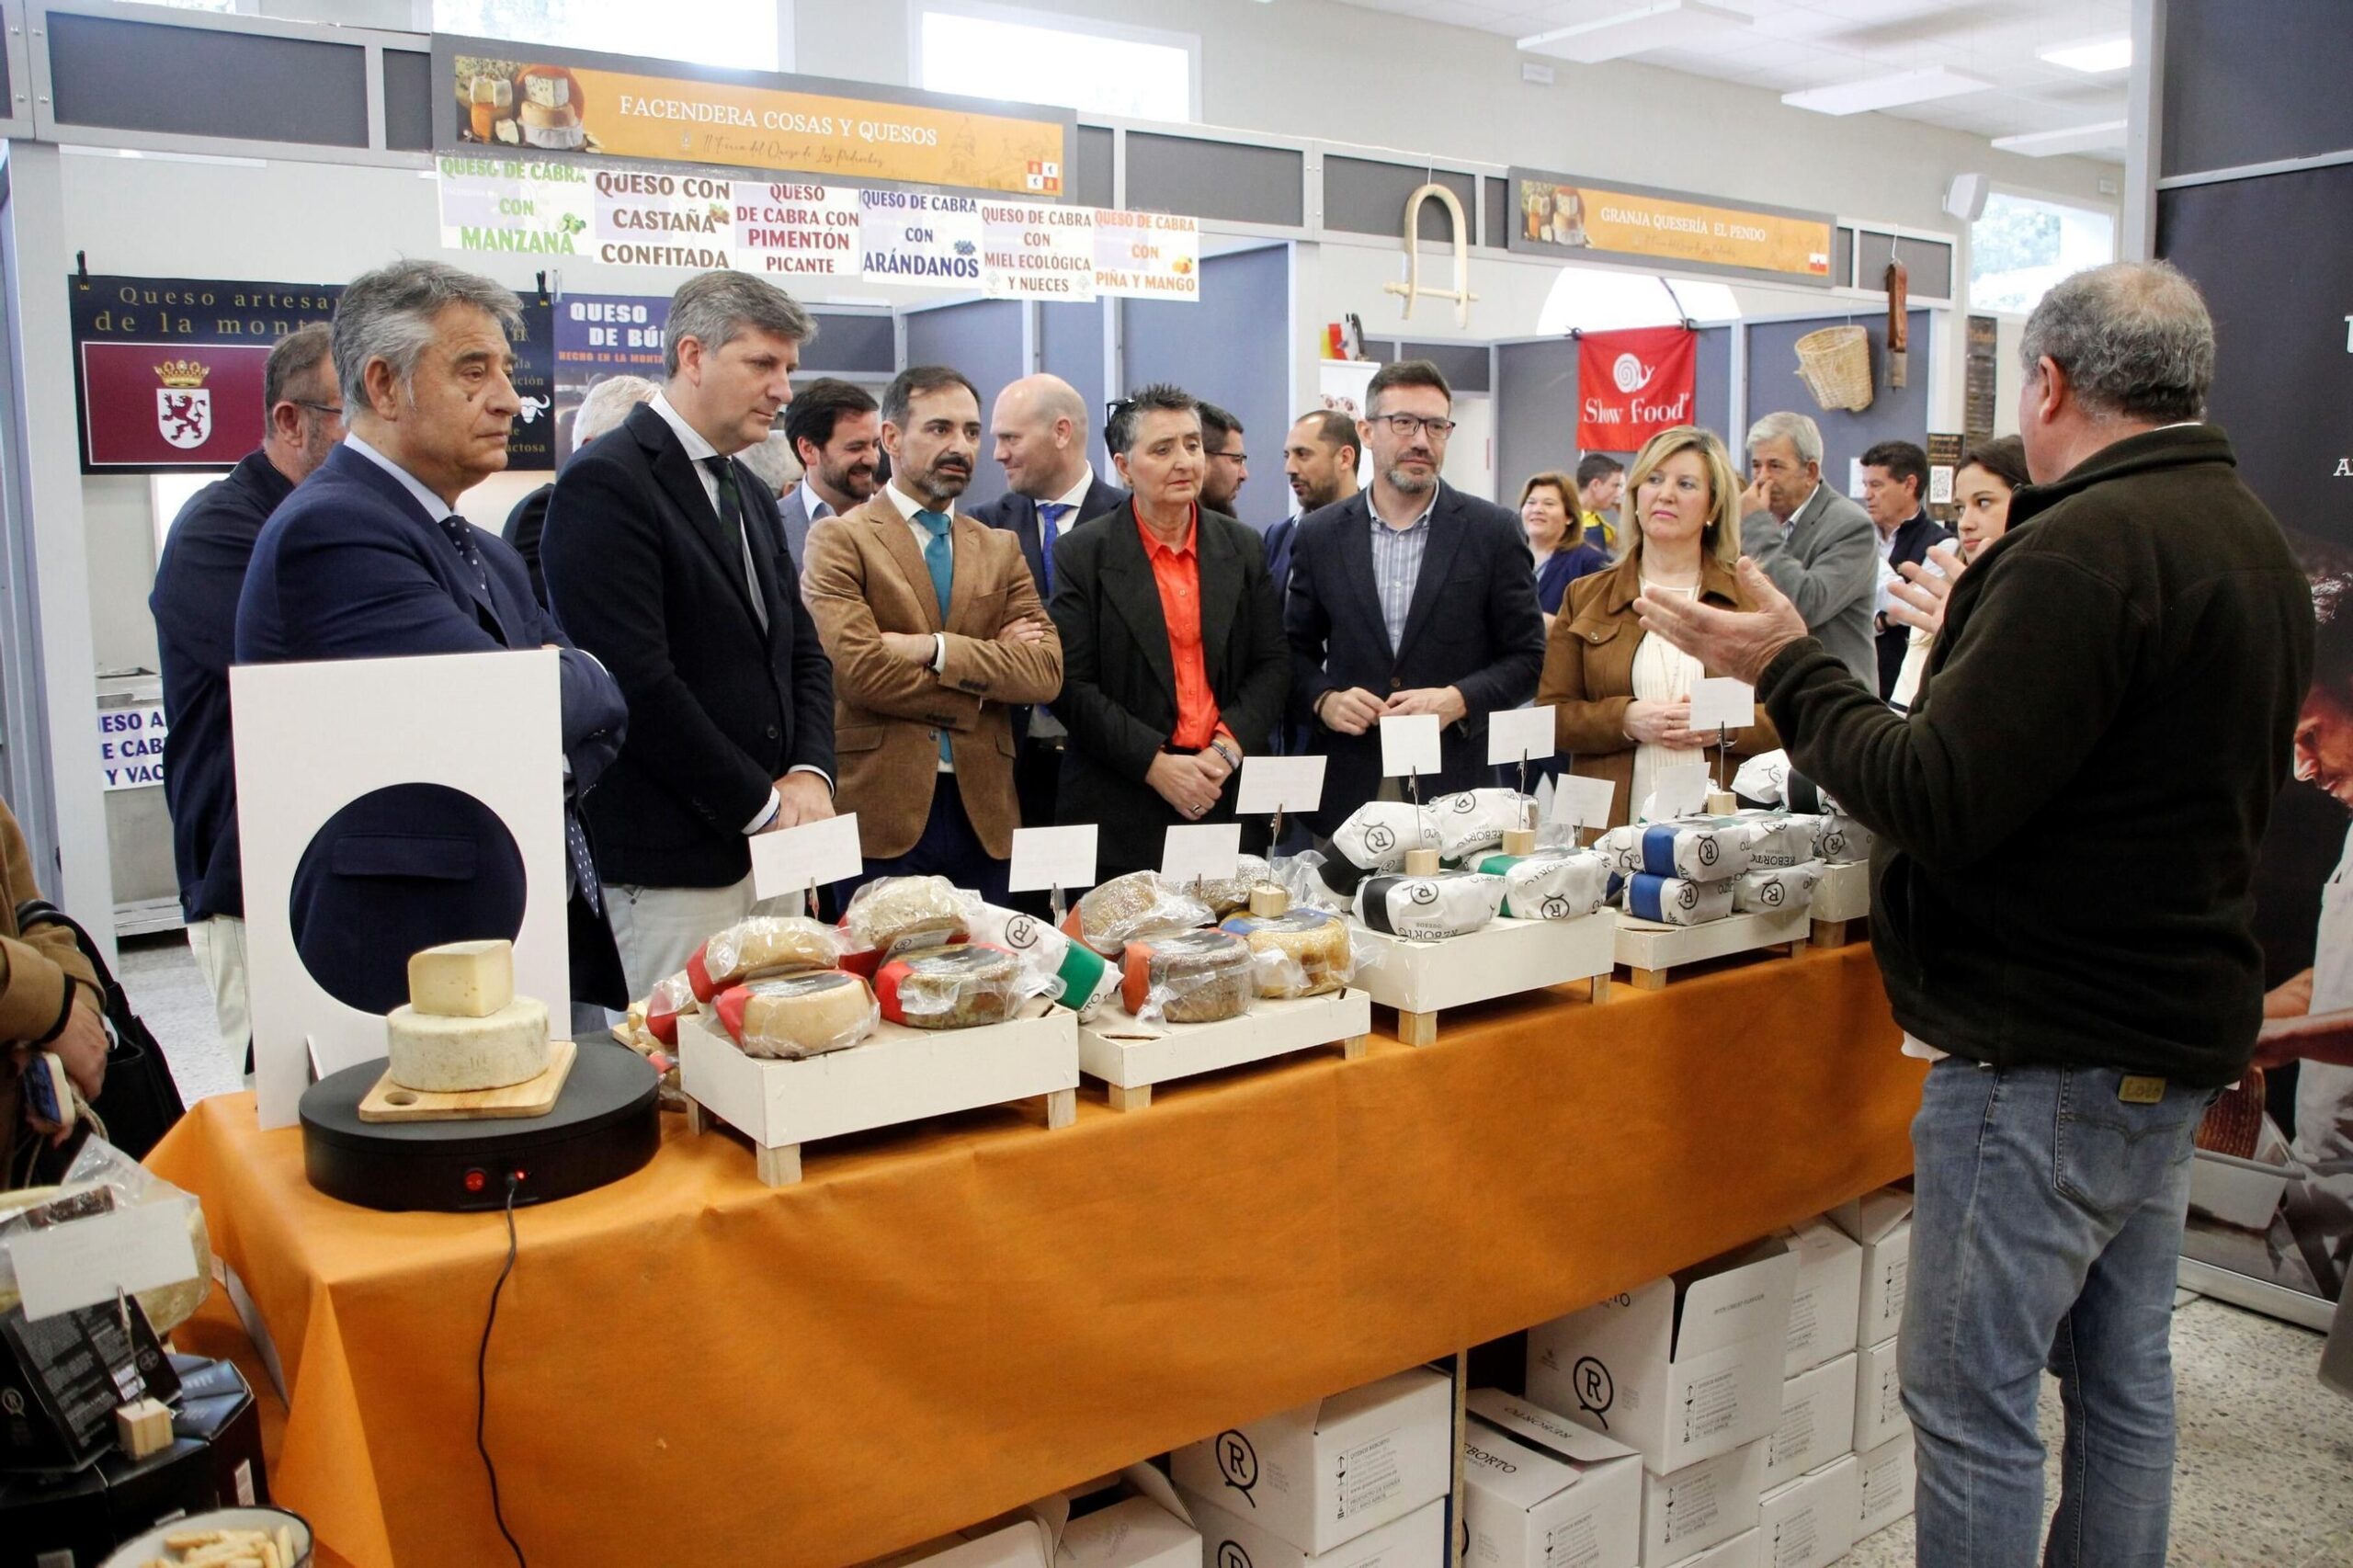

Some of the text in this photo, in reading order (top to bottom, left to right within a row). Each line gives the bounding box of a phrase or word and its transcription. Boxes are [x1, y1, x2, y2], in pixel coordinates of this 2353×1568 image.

[619, 95, 938, 146] FACENDERA COSAS Y QUESOS
[505, 161, 526, 180] DE
[530, 162, 586, 184] CABRA
[595, 171, 730, 199] QUESO CON
[770, 184, 824, 203] QUESO
[499, 198, 534, 216] CON
[862, 189, 977, 213] QUESO DE CABRA
[612, 208, 717, 234] CASTAÑA
[737, 207, 859, 227] DE CABRA CON
[982, 206, 1092, 227] QUESO DE CABRA
[1095, 210, 1195, 232] QUESO DE CABRA
[1600, 208, 1766, 243] GRANJA QUESERÍA EL PENDO
[460, 227, 575, 256] MANZANA
[748, 228, 850, 250] PIMENTÓN
[905, 228, 933, 243] CON
[1024, 232, 1051, 246] CON
[601, 244, 730, 269] CONFITADA
[984, 253, 1014, 268] MIEL
[1132, 244, 1159, 259] CON
[767, 256, 835, 274] PICANTE
[863, 248, 979, 278] ARÁNDANOS
[1007, 277, 1069, 292] Y NUECES
[1096, 269, 1195, 291] PIÑA Y MANGO
[119, 286, 215, 306] Queso
[95, 311, 136, 332] de
[161, 312, 192, 334] la
[570, 302, 648, 324] QUESO
[588, 327, 619, 347] DE
[558, 351, 594, 362] HECHO
[597, 352, 610, 362] EN
[615, 352, 626, 363] LA
[1584, 397, 1623, 424] Slow
[98, 713, 142, 733] ESO
[106, 768, 118, 786] Y
